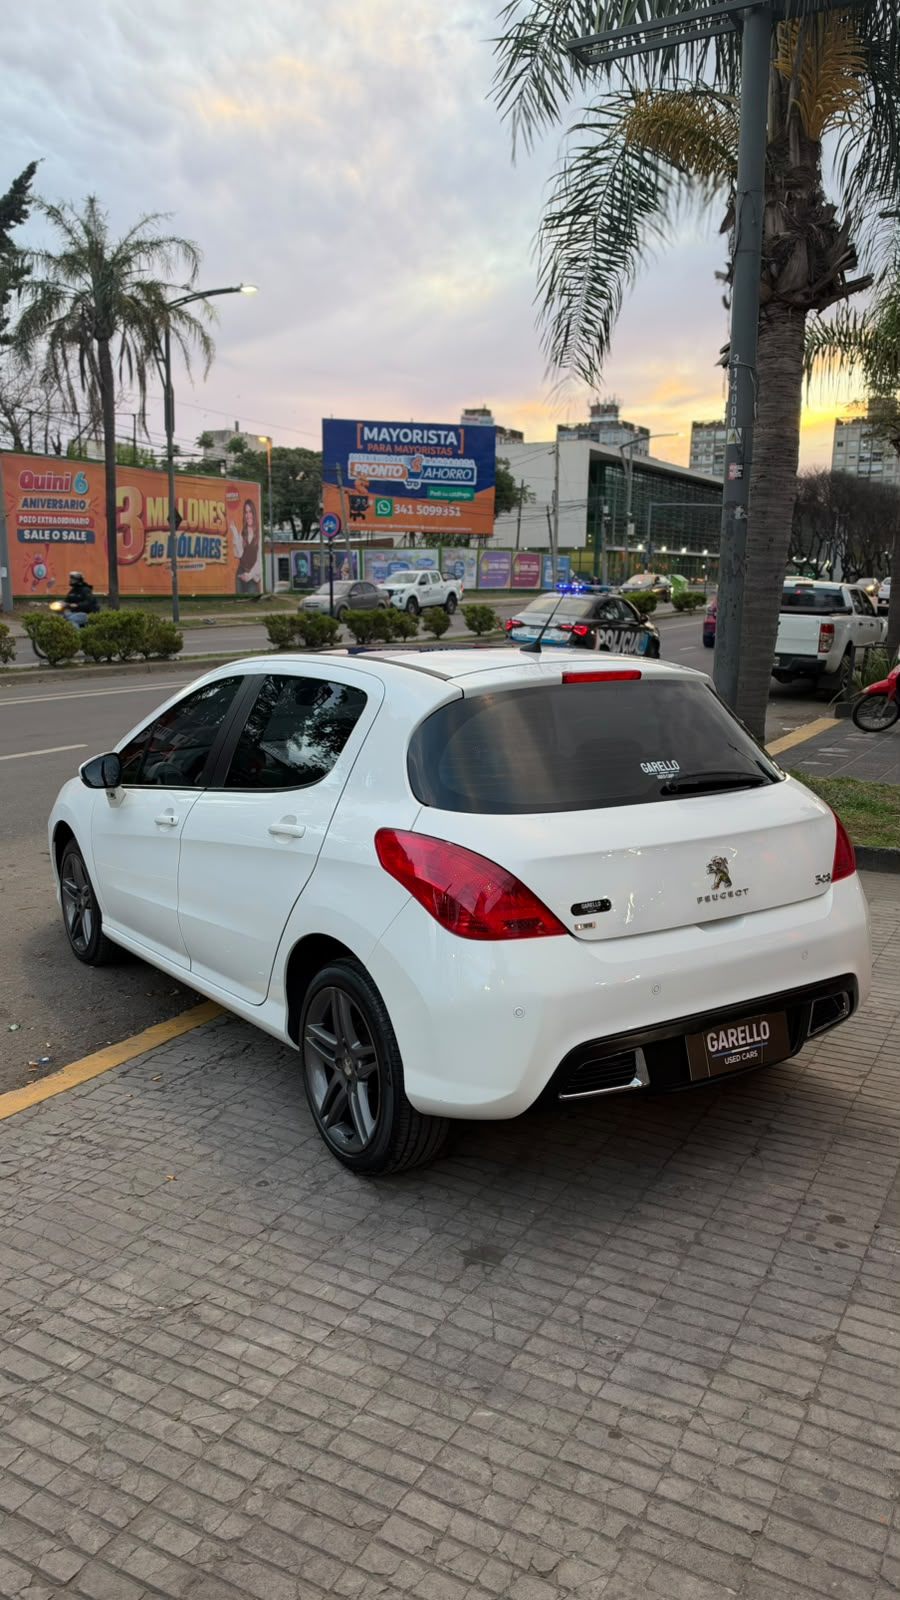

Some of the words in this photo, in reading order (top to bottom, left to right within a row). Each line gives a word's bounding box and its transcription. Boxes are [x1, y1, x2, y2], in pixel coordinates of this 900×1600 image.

[363, 427, 458, 446] MAYORISTA
[367, 443, 392, 453] PARA
[394, 445, 453, 456] MAYORISTAS
[354, 463, 403, 477] PRONTO
[424, 467, 472, 480] AHORRO
[20, 470, 71, 493] Quini
[74, 471, 88, 496] 6
[22, 498, 86, 510] ANIVERSARIO
[394, 504, 414, 514] 341
[19, 515, 36, 524] POZO
[37, 516, 89, 525] EXTRAORDINARIO
[146, 497, 226, 529] MILONES
[115, 485, 145, 561] 3
[24, 530, 50, 540] SALE
[52, 530, 60, 540] O
[62, 531, 87, 541] SALE
[150, 541, 164, 558] de
[640, 760, 680, 773] GARELLO
[697, 888, 749, 904] PEUGEOT
[707, 1021, 770, 1052] GARELLO
[725, 1055, 741, 1064] USED
[742, 1050, 758, 1060] CARS
